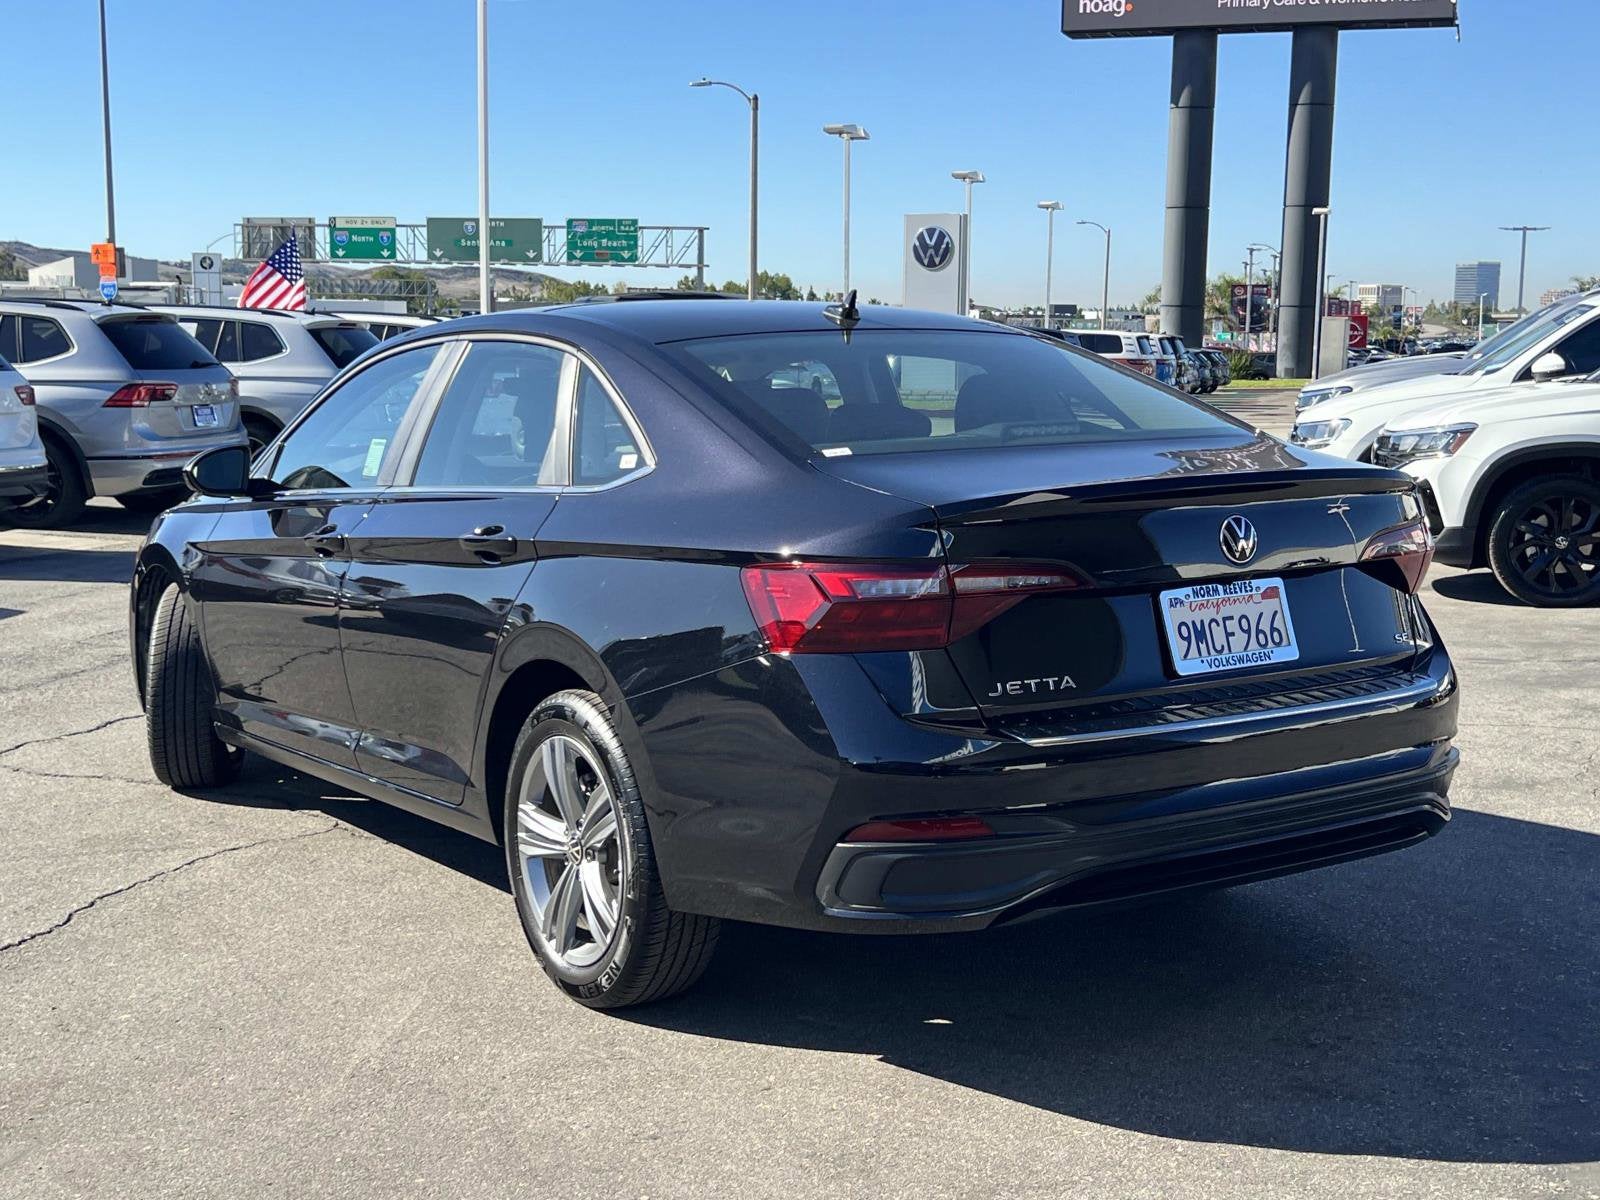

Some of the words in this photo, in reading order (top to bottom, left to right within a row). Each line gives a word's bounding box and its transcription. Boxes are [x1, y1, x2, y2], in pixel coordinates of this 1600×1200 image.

[351, 234, 374, 242] NORTH
[460, 238, 480, 247] Sant
[489, 239, 506, 247] Ana
[577, 239, 598, 249] Long
[601, 238, 628, 248] Beach
[1191, 584, 1221, 599] NORM
[1222, 581, 1254, 598] REEVES
[1169, 597, 1185, 609] APR
[1188, 594, 1263, 615] California
[1177, 609, 1283, 660] 9MCF966
[1394, 632, 1409, 644] SE
[1206, 650, 1272, 669] VOLKSWAGEN
[988, 675, 1077, 697] JETTA
